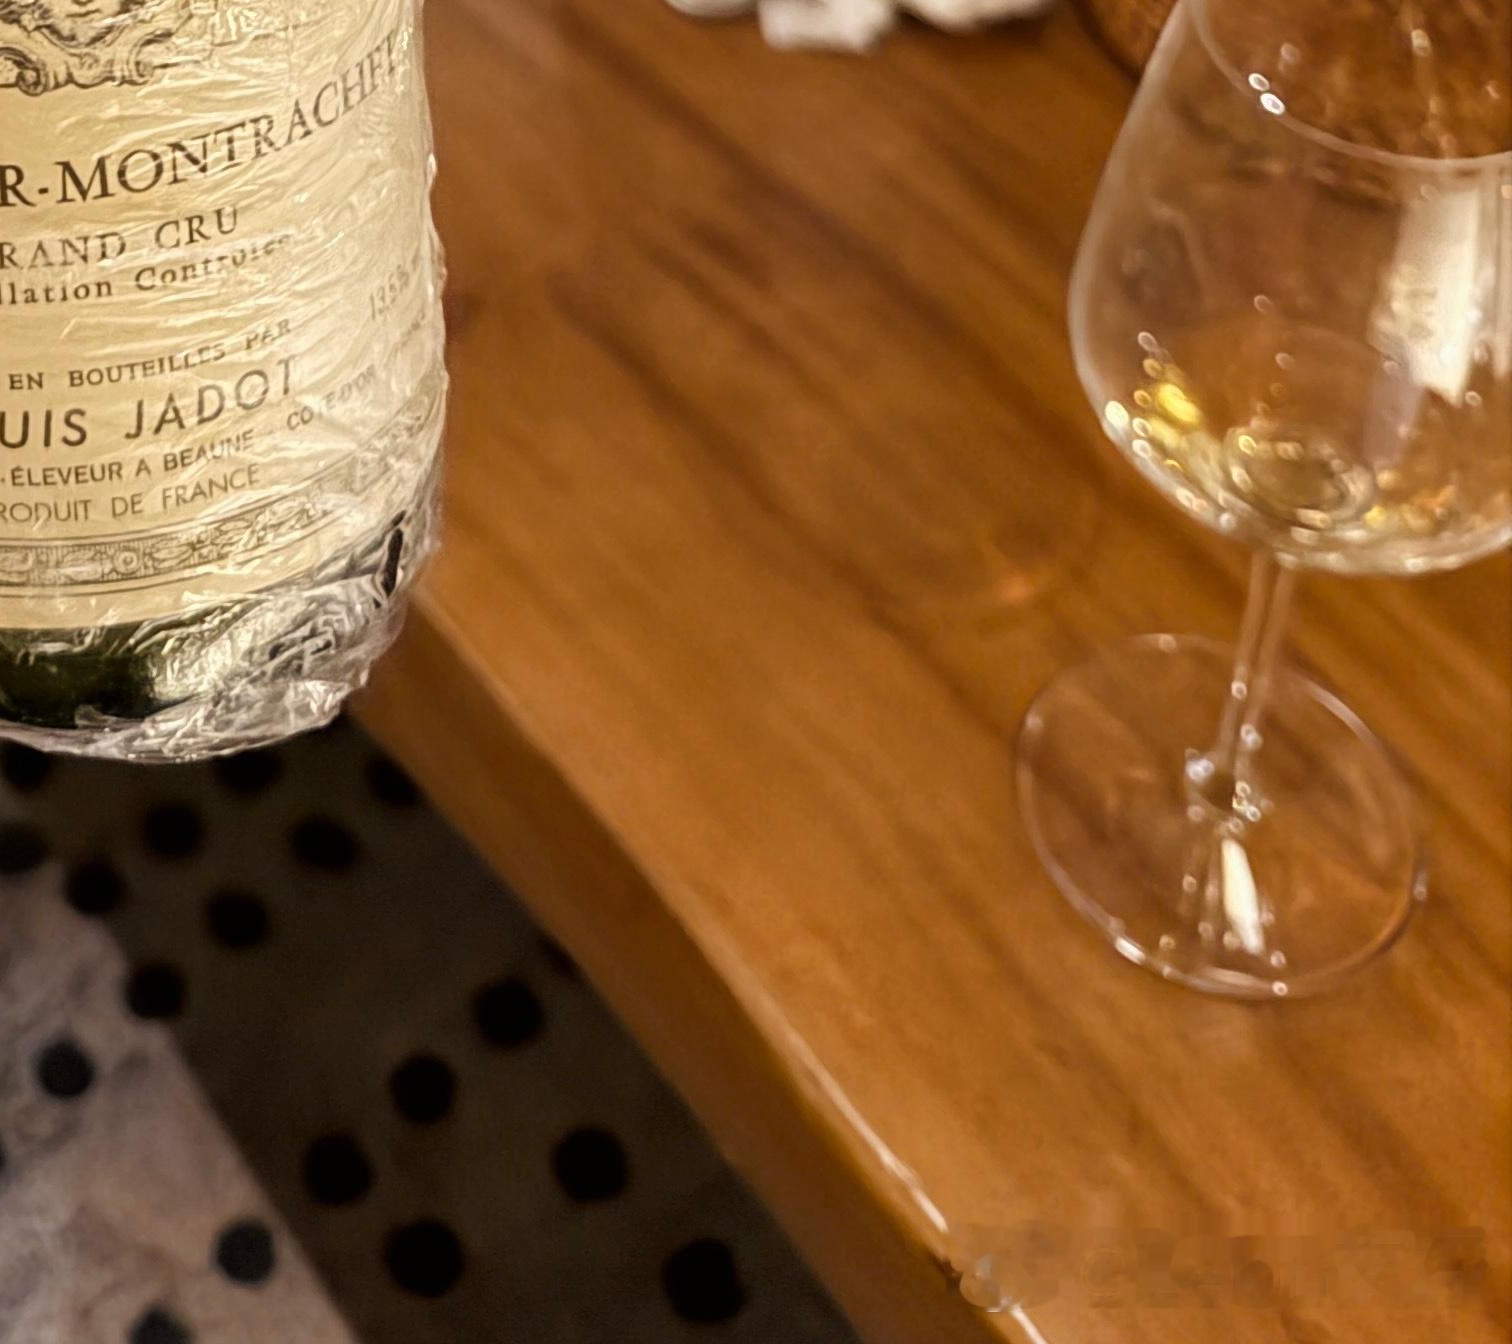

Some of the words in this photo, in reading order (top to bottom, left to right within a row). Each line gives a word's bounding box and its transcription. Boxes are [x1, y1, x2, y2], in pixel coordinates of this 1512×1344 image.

[155, 207, 238, 249] CRU
[8, 372, 44, 391] EN
[68, 342, 226, 388] BOUTEILLES
[245, 318, 292, 350] PAR
[124, 358, 299, 440] JADOT
[163, 428, 255, 472] BEAUNE
[111, 492, 143, 519] DE
[161, 463, 261, 513] FRANCE
